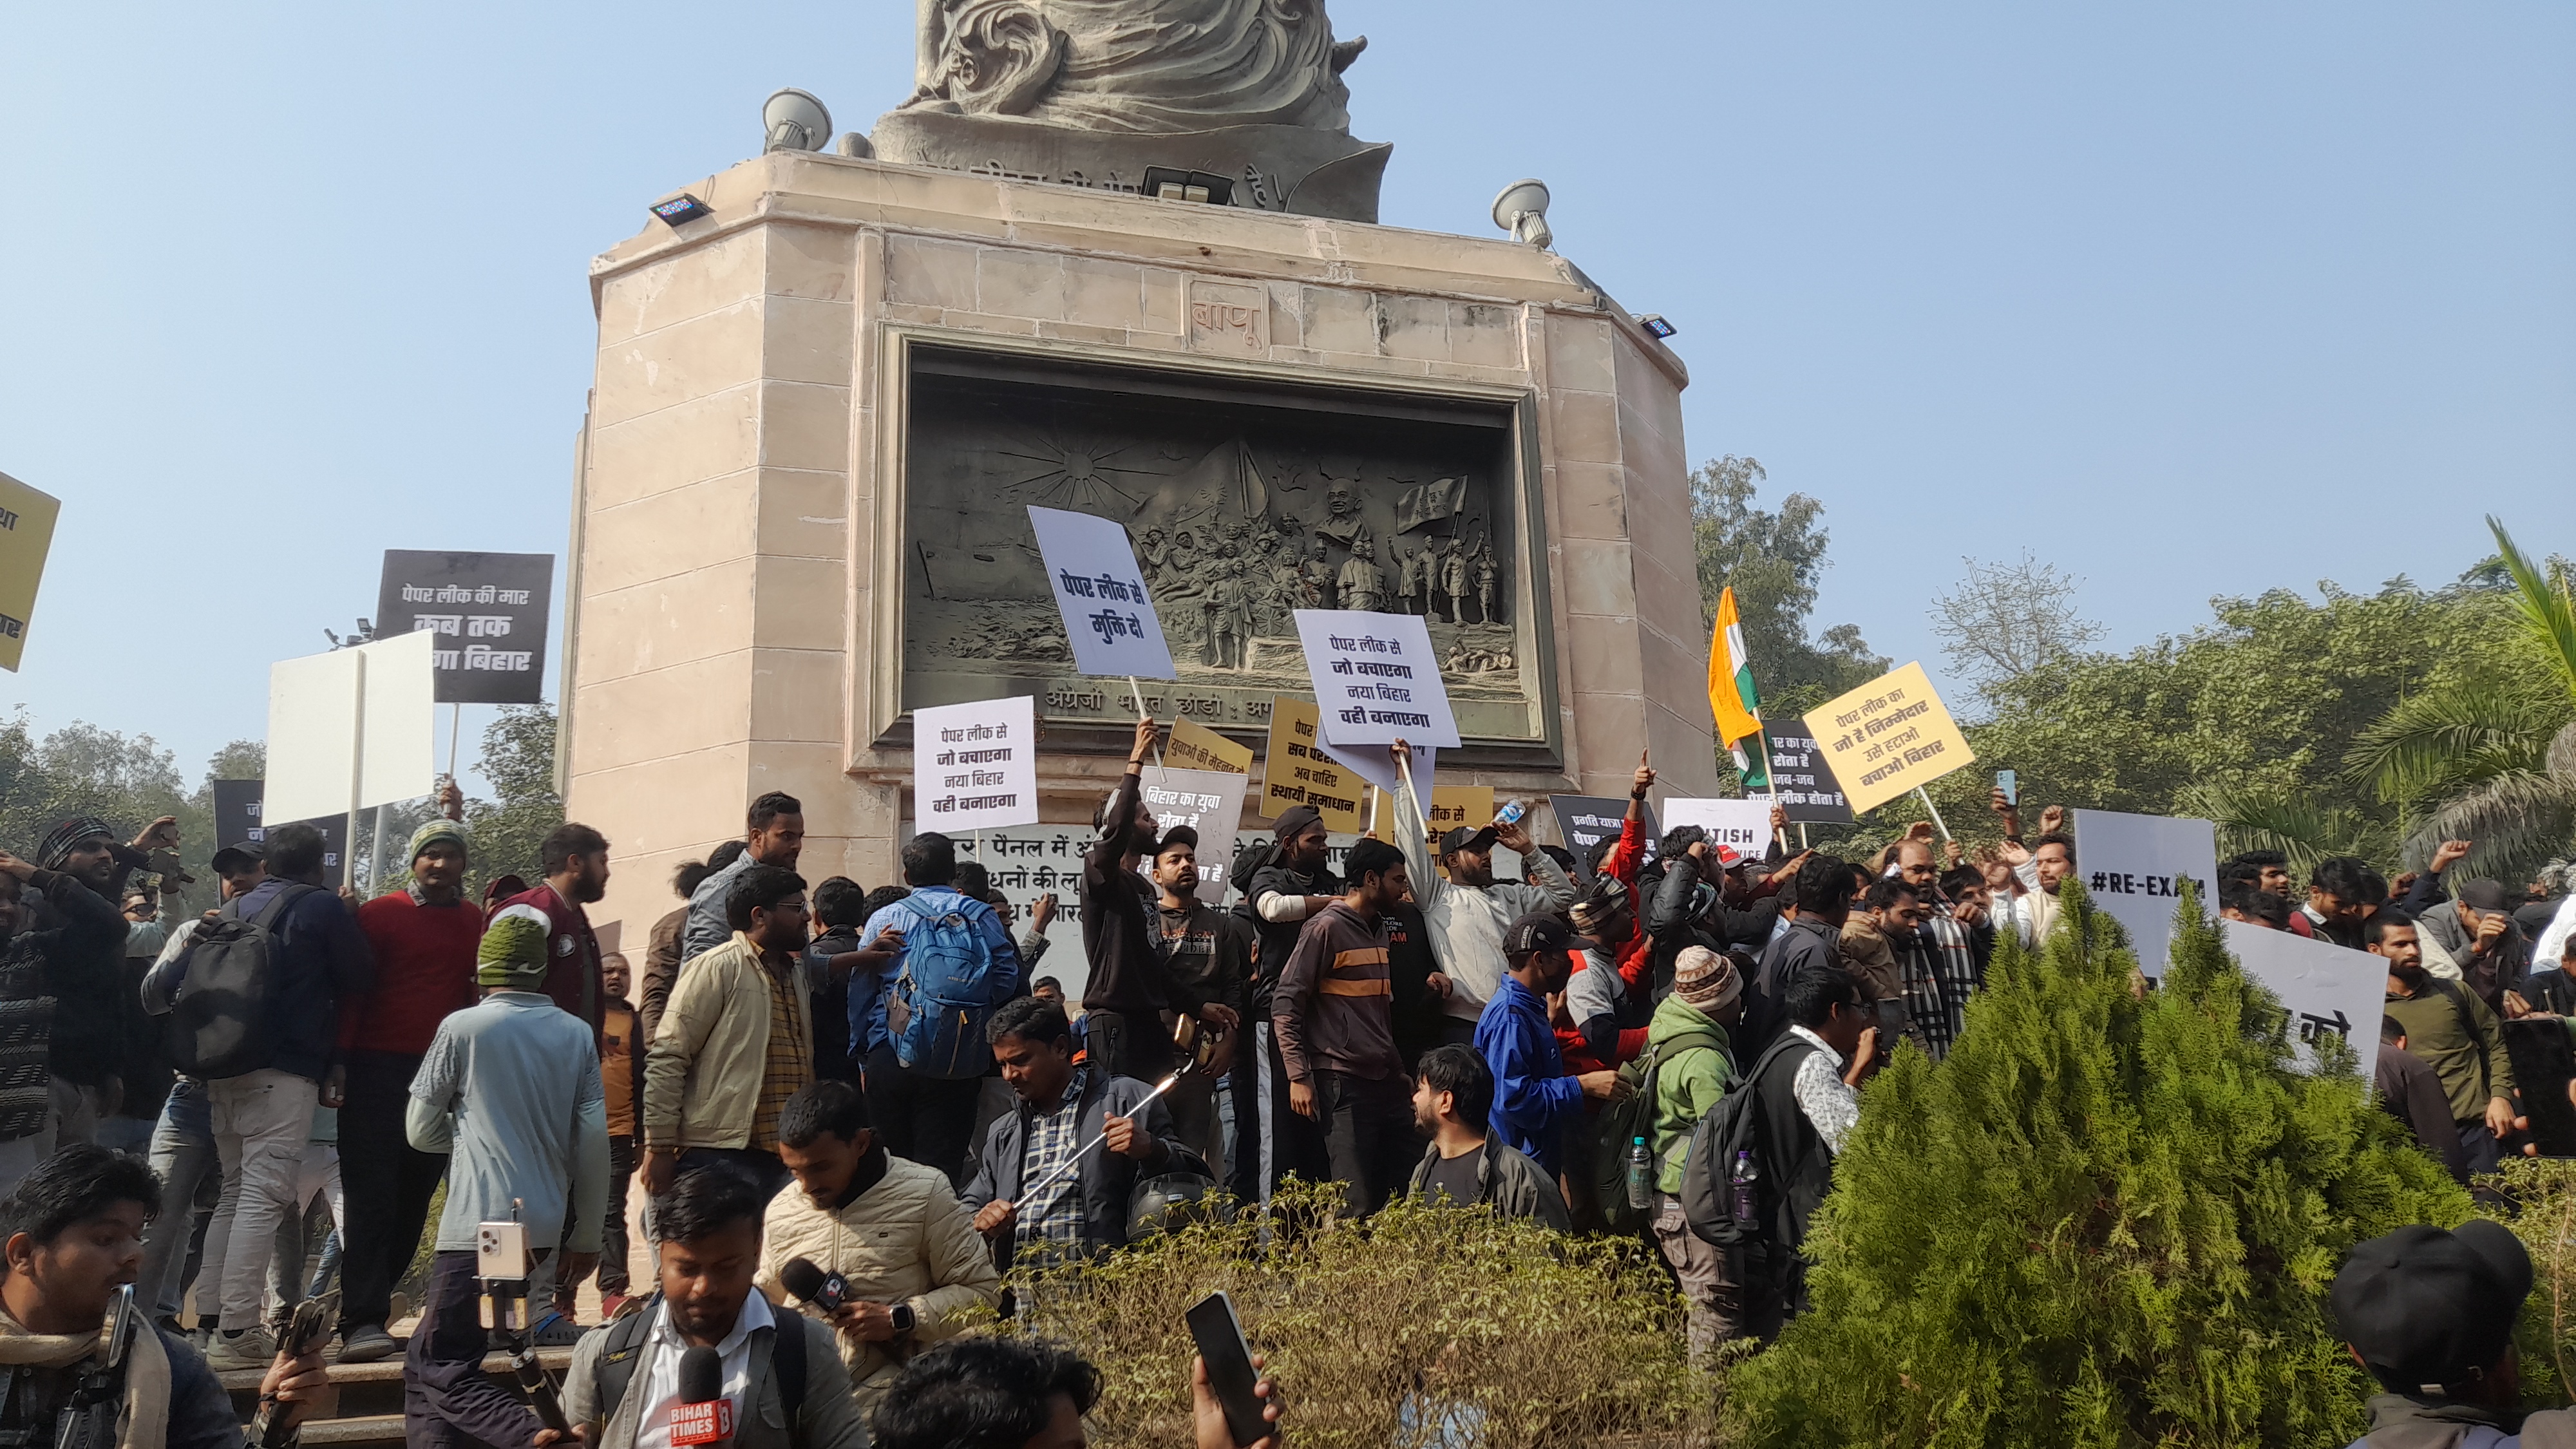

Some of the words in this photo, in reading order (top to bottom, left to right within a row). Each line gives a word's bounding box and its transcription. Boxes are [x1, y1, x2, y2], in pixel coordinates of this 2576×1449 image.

[1192, 302, 1262, 350] बापू
[402, 583, 435, 603] पेपर
[436, 584, 473, 604] लीक
[475, 585, 496, 604] की
[498, 589, 530, 605] मार
[1059, 568, 1095, 597] पेपर
[1094, 573, 1130, 602] लीक
[1128, 579, 1146, 605] से
[414, 614, 463, 636] कब
[467, 616, 513, 637] तक
[1088, 609, 1127, 645] मुक्ति
[1126, 612, 1144, 639] दो
[1329, 634, 1356, 651] पेपर
[1358, 636, 1387, 653] लीक
[1388, 638, 1402, 655] से
[464, 645, 533, 671] बिहार
[1331, 658, 1353, 675] जो
[1355, 661, 1413, 679] बचाएगा
[1116, 693, 1164, 713] भारत
[1345, 686, 1375, 699] नया
[1376, 683, 1412, 703] बिहार
[1338, 706, 1367, 724] वही
[1369, 710, 1431, 728] बनाएगा
[1835, 709, 1861, 727] पेपर
[1859, 696, 1888, 717] लीक
[1886, 688, 1906, 703] का
[941, 727, 964, 743] पेपर
[966, 724, 993, 741] लीक
[996, 722, 1008, 739] से
[1295, 718, 1313, 737] पेपर
[1832, 734, 1855, 753] जो
[1852, 727, 1866, 743] है
[1864, 699, 1929, 737] जिम्मेदार
[1171, 737, 1197, 760] युवाओं
[1197, 748, 1209, 765] की
[1288, 742, 1307, 759] सब
[1785, 737, 1800, 748] का
[1862, 743, 1885, 762] उसे
[1882, 726, 1920, 753] हटाओ
[936, 749, 955, 766] जो
[958, 748, 1012, 764] बचाएगा
[1772, 752, 1798, 766] रोता
[1799, 753, 1810, 767] है
[1859, 757, 1906, 787] बचाओ
[1903, 739, 1946, 767] बिहार
[944, 774, 969, 788] नया
[972, 770, 1005, 786] बिहार
[1294, 766, 1310, 781] अब
[1312, 770, 1338, 788] चाहिए
[1773, 774, 1815, 786] जब-जब
[933, 795, 956, 813] वही
[959, 794, 1017, 810] बनाएगा
[1145, 786, 1178, 804] बिहार
[1180, 792, 1197, 806] का
[1198, 793, 1221, 812] युवा
[1271, 784, 1305, 803] स्थायी
[1307, 792, 1355, 814] समाधान
[1776, 790, 1806, 804] लीक
[1807, 790, 1833, 805] होता
[1834, 791, 1844, 806] है
[1158, 810, 1186, 828] रोता
[1453, 805, 1465, 821] से
[1571, 814, 1598, 827] प्रगति
[1598, 817, 1622, 829] यात्रा
[991, 833, 1045, 858] पैनल
[1051, 833, 1070, 858] में
[1707, 828, 1753, 843] TISH
[1032, 865, 1058, 889] की
[1211, 863, 1223, 882] है
[670, 1403, 713, 1423] BIHAR
[670, 1417, 714, 1438] TIMES
